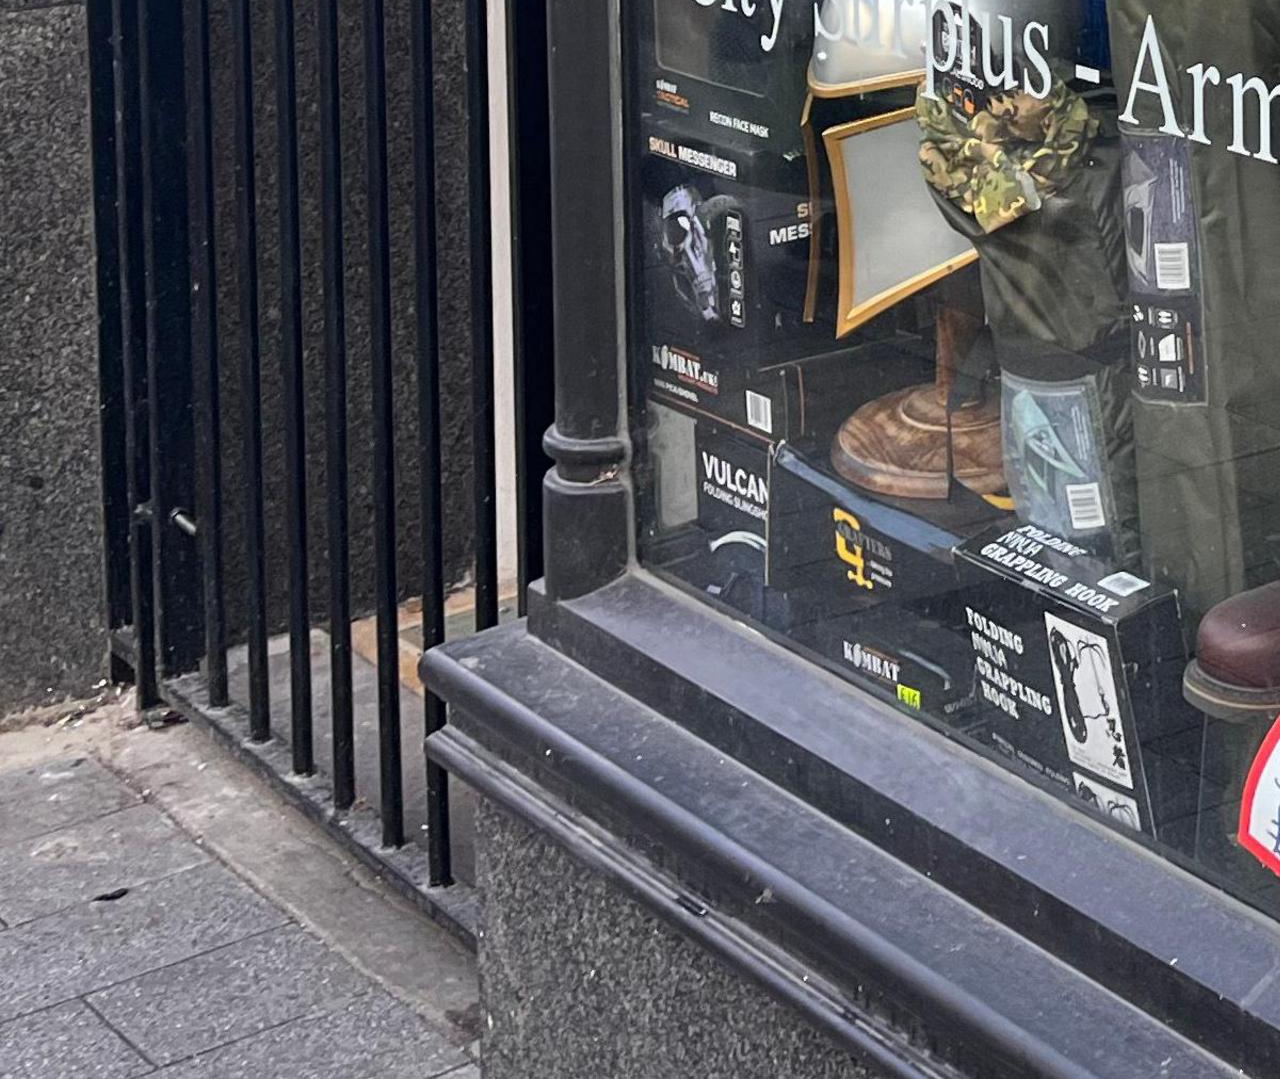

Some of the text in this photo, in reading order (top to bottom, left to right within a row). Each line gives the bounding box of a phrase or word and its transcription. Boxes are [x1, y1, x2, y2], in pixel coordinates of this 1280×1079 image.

[1075, 63, 1101, 84] -
[732, 117, 751, 133] FACE
[749, 123, 769, 138] MASK
[649, 136, 737, 178] SKULL MESSENGER
[702, 450, 769, 505] VULCAN
[996, 530, 1045, 559] NINJA
[1014, 523, 1088, 558] FOLDING
[980, 542, 1120, 614] GRAPPLING HOOK
[965, 606, 1024, 656] FOLDING
[971, 630, 1008, 670] NINJA
[976, 655, 1053, 716] GRAPPLING
[981, 679, 1020, 720] HOOK
